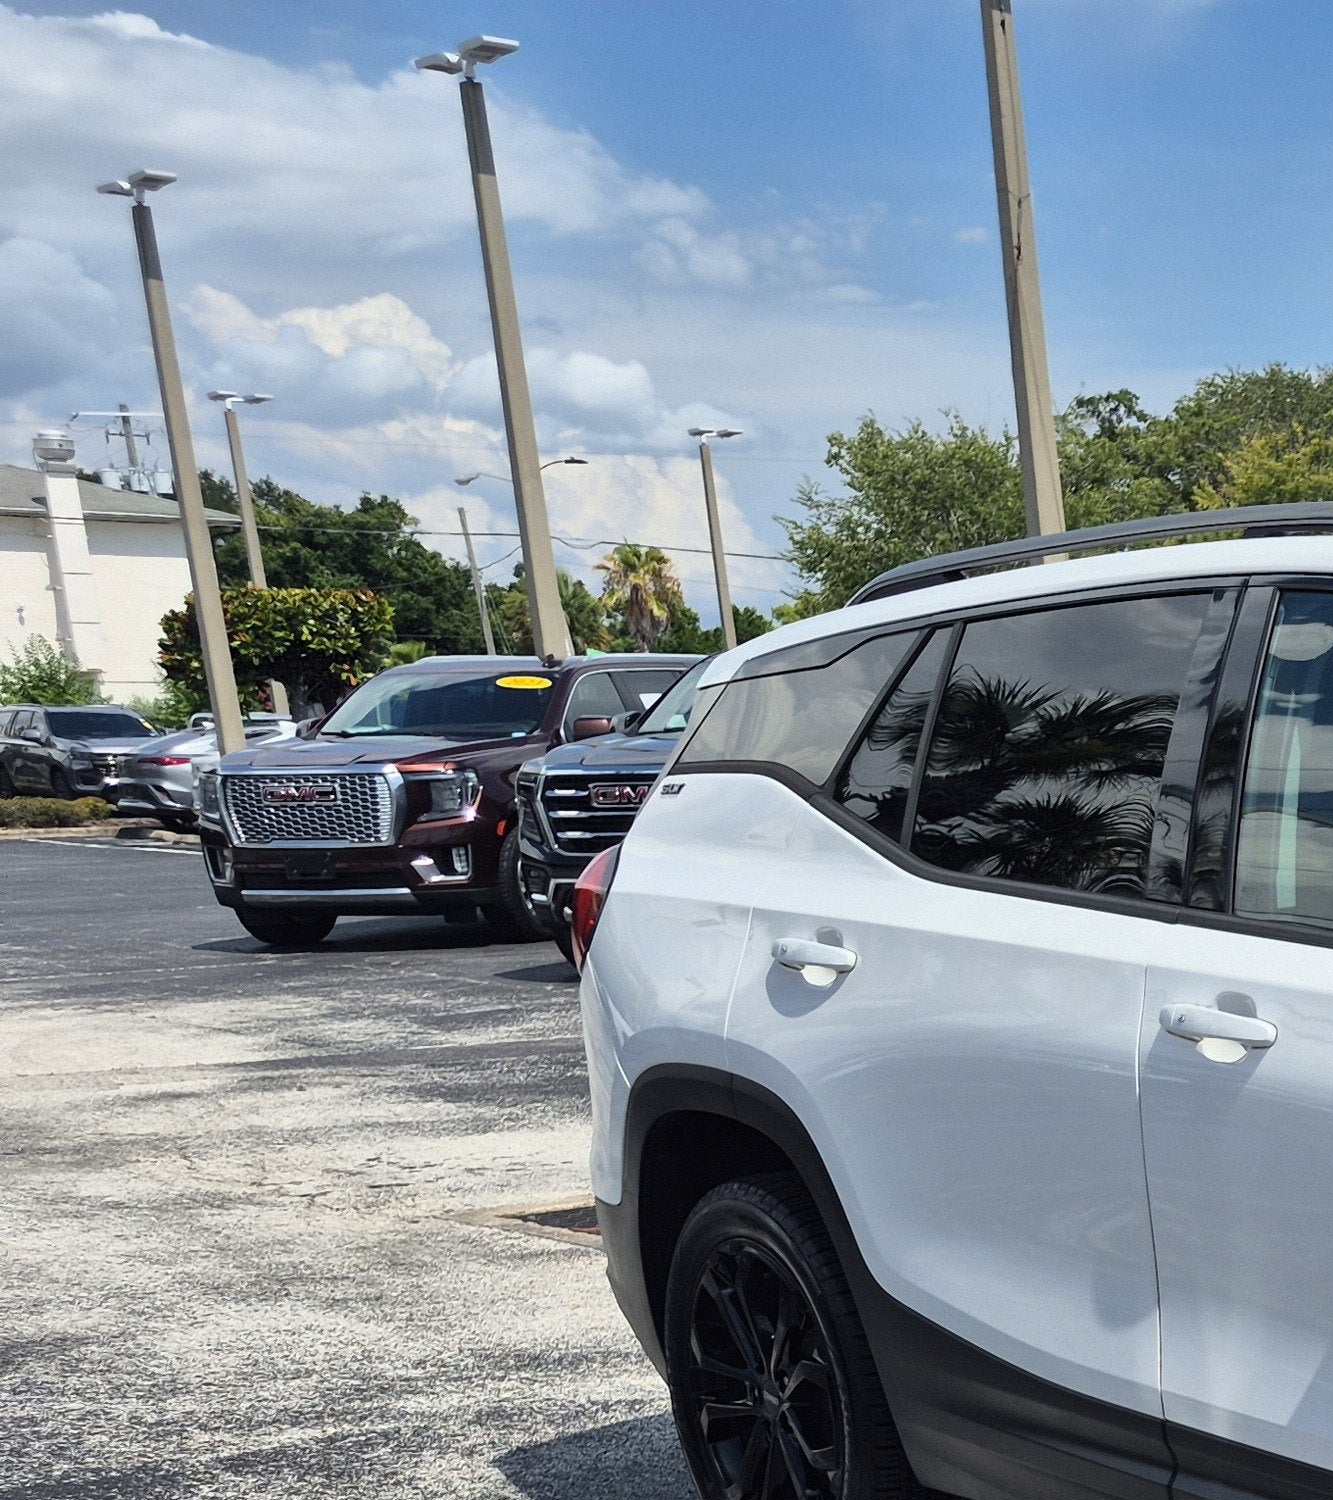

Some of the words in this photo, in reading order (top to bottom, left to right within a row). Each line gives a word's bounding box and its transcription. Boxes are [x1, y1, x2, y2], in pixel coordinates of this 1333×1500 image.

[264, 786, 334, 801] GMC
[594, 785, 649, 804] GM
[661, 783, 686, 796] SLT
